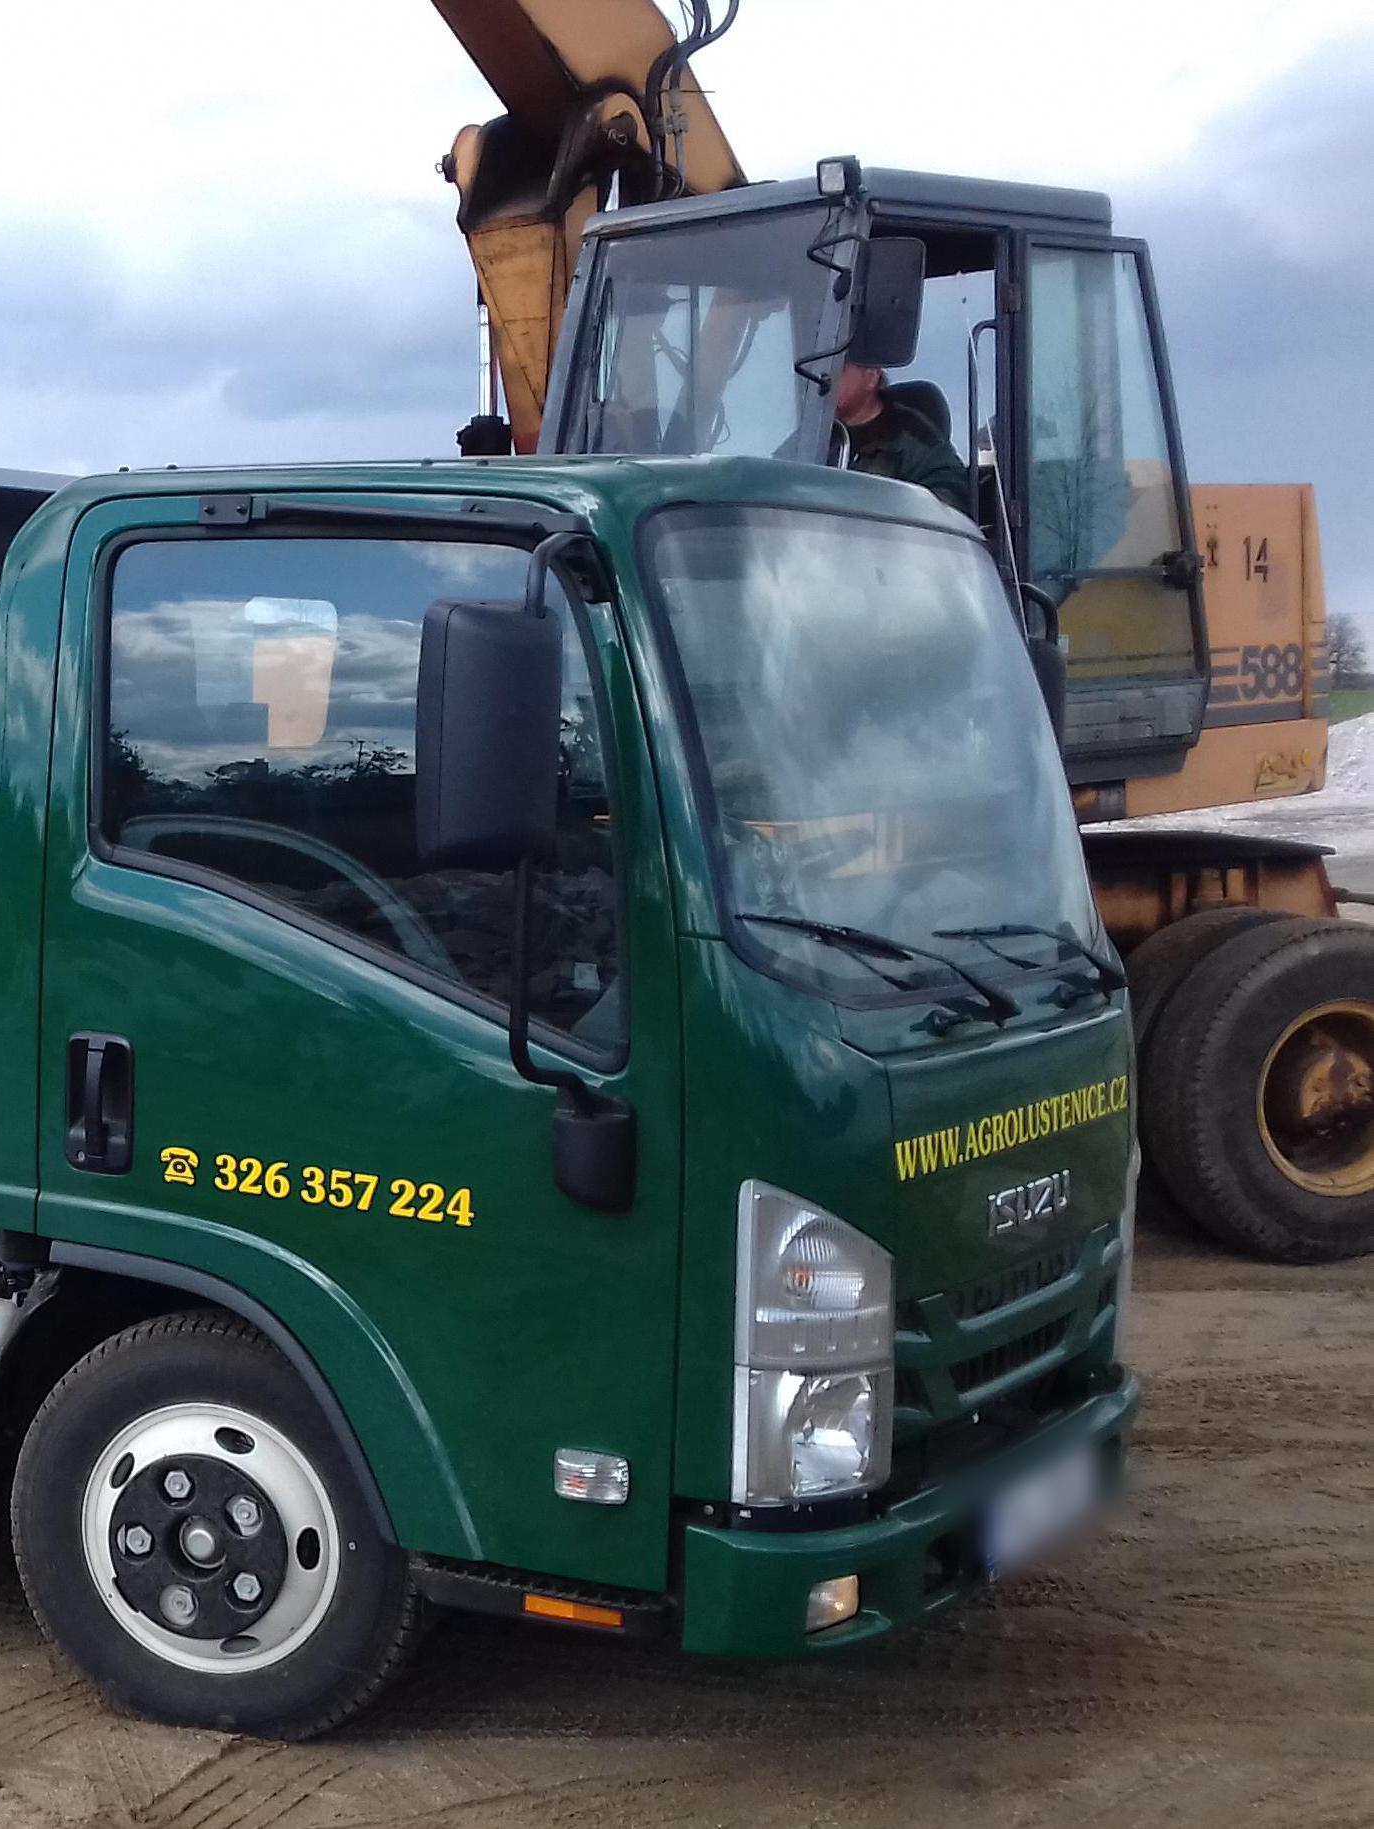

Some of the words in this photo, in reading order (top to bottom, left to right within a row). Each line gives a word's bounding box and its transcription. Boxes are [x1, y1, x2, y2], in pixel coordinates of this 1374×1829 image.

[1243, 535, 1268, 583] 14
[1240, 645, 1303, 699] 588
[895, 1075, 1128, 1181] WWW.AGROLUSTENICE.CZ
[213, 1154, 292, 1199] 326
[300, 1166, 380, 1211] 357
[389, 1178, 475, 1227] 224
[987, 1168, 1070, 1236] ISUZU
